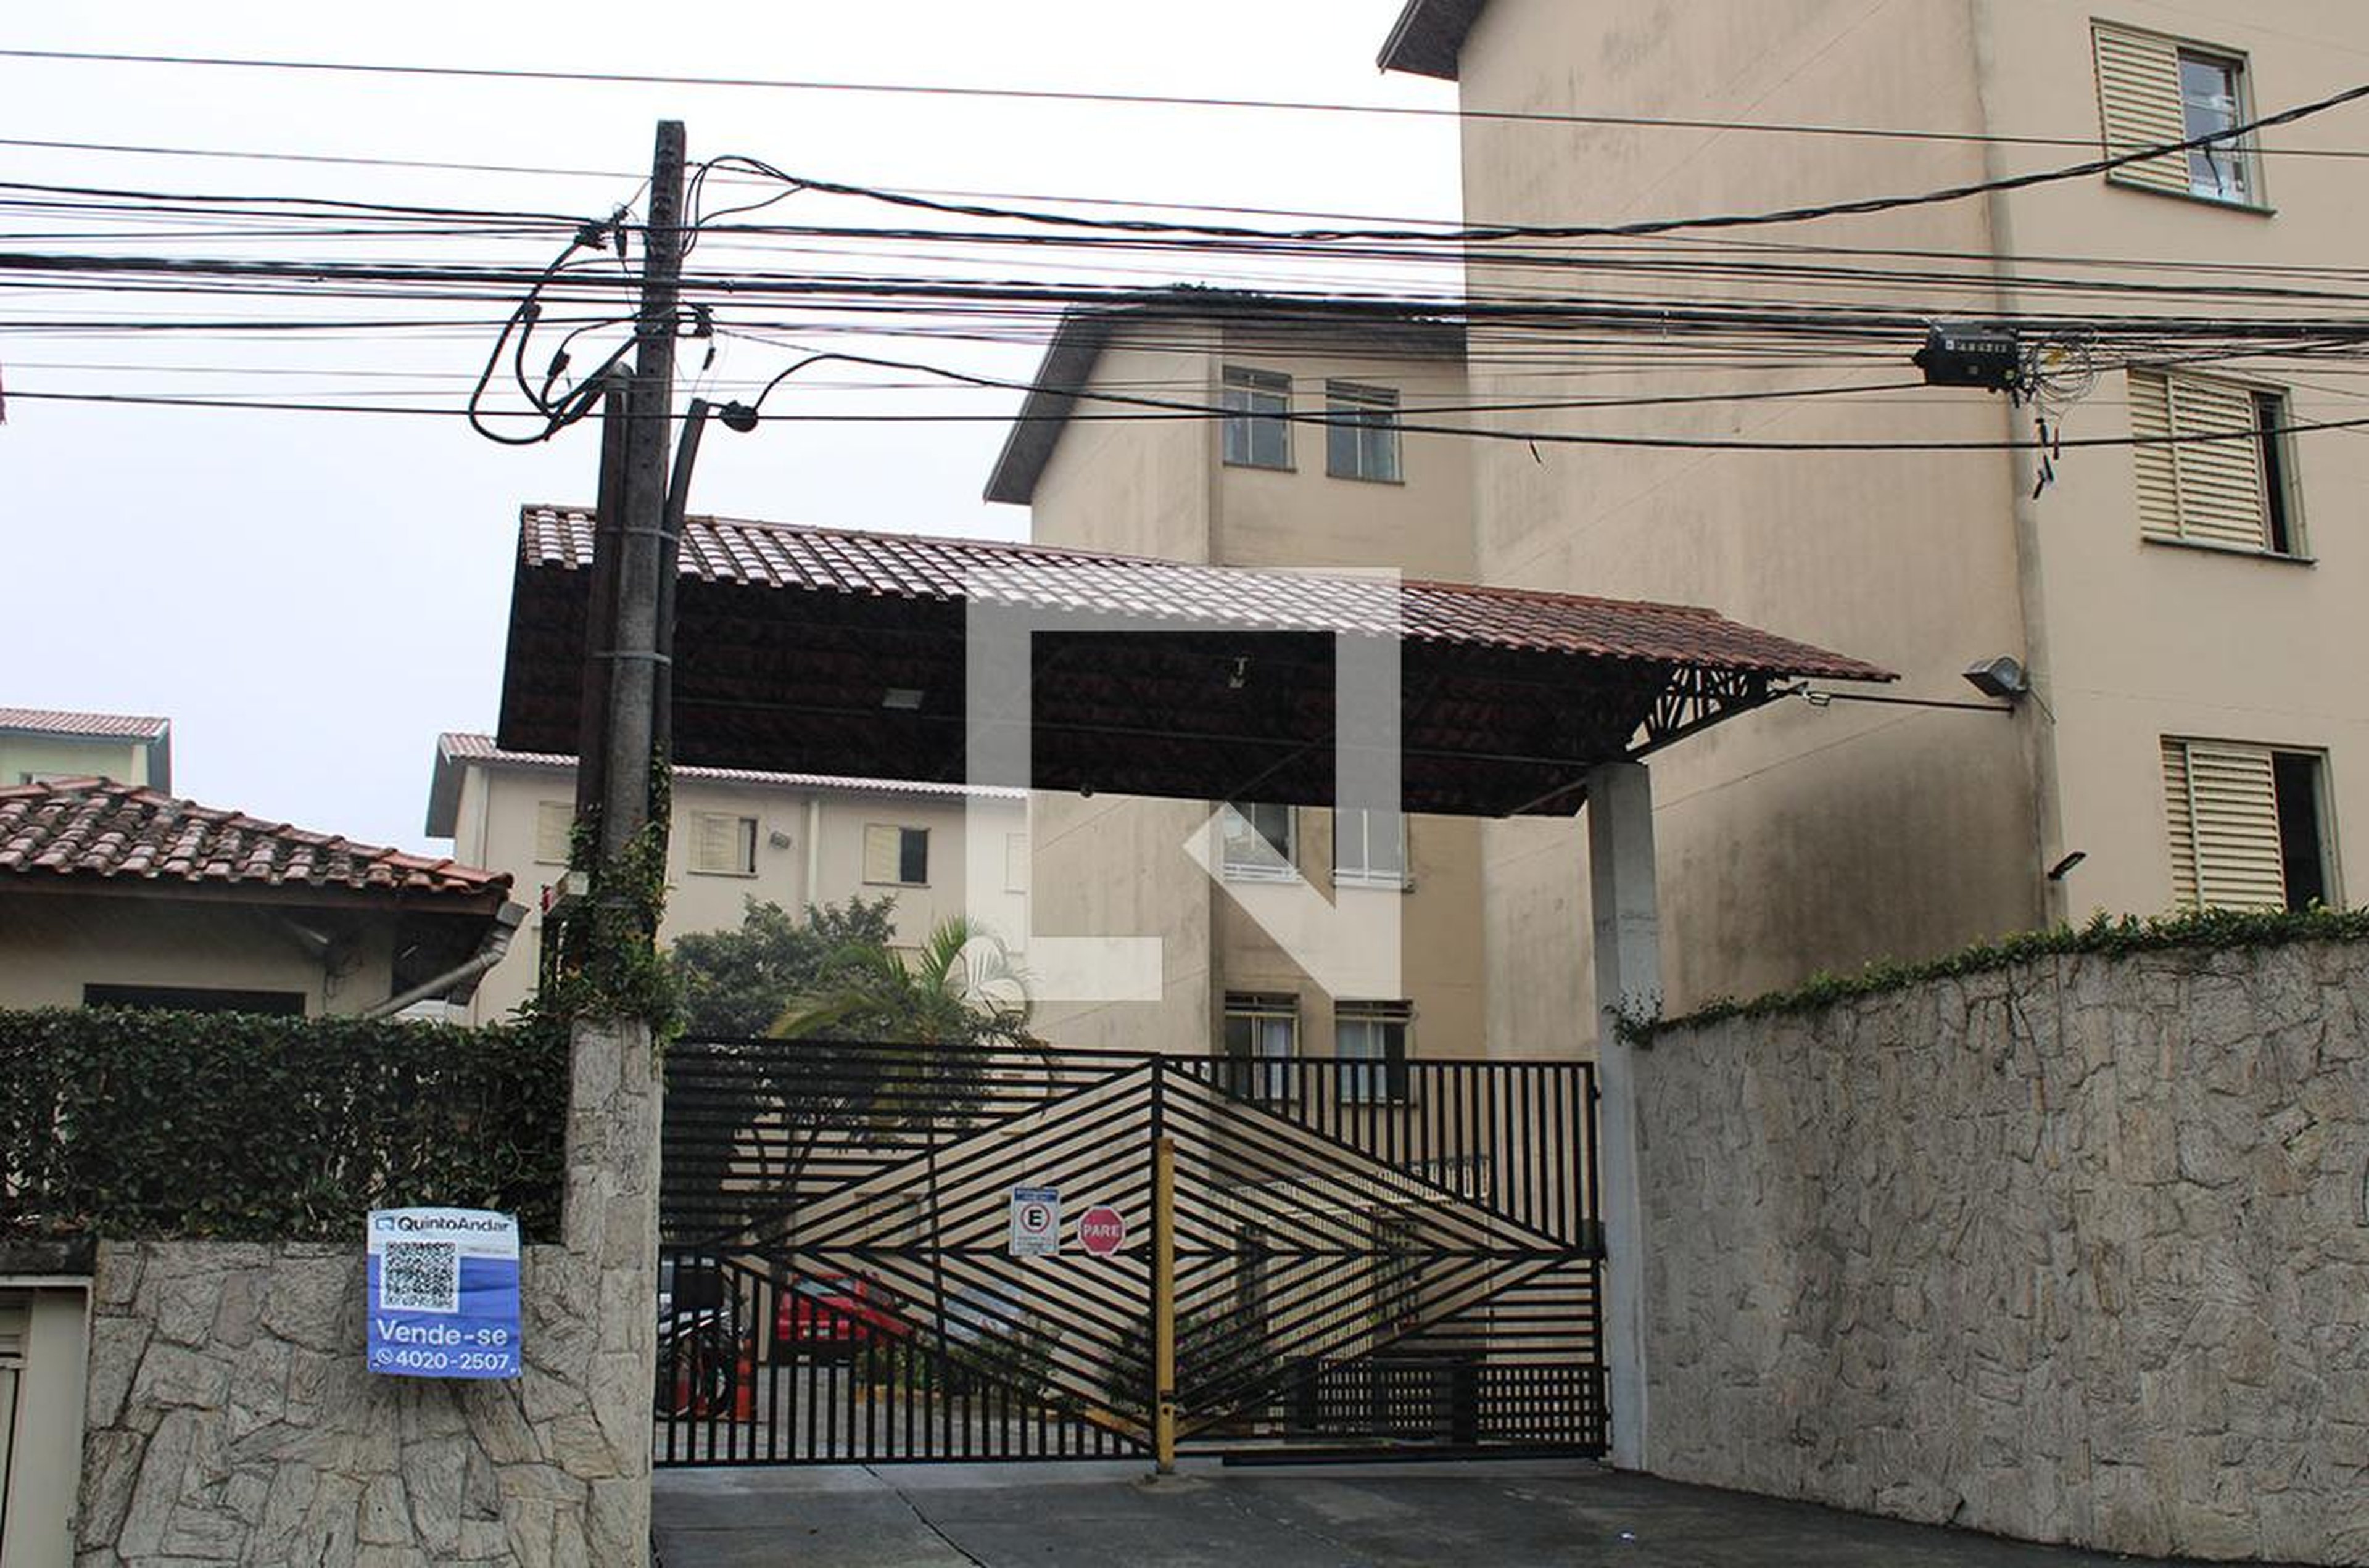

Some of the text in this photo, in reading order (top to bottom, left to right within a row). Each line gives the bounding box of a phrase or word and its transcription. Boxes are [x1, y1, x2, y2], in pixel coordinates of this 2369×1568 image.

[398, 1216, 510, 1232] QuintoAndar
[1028, 1210, 1042, 1227] E
[1083, 1224, 1121, 1237] PARE
[377, 1319, 508, 1345] Vende-se
